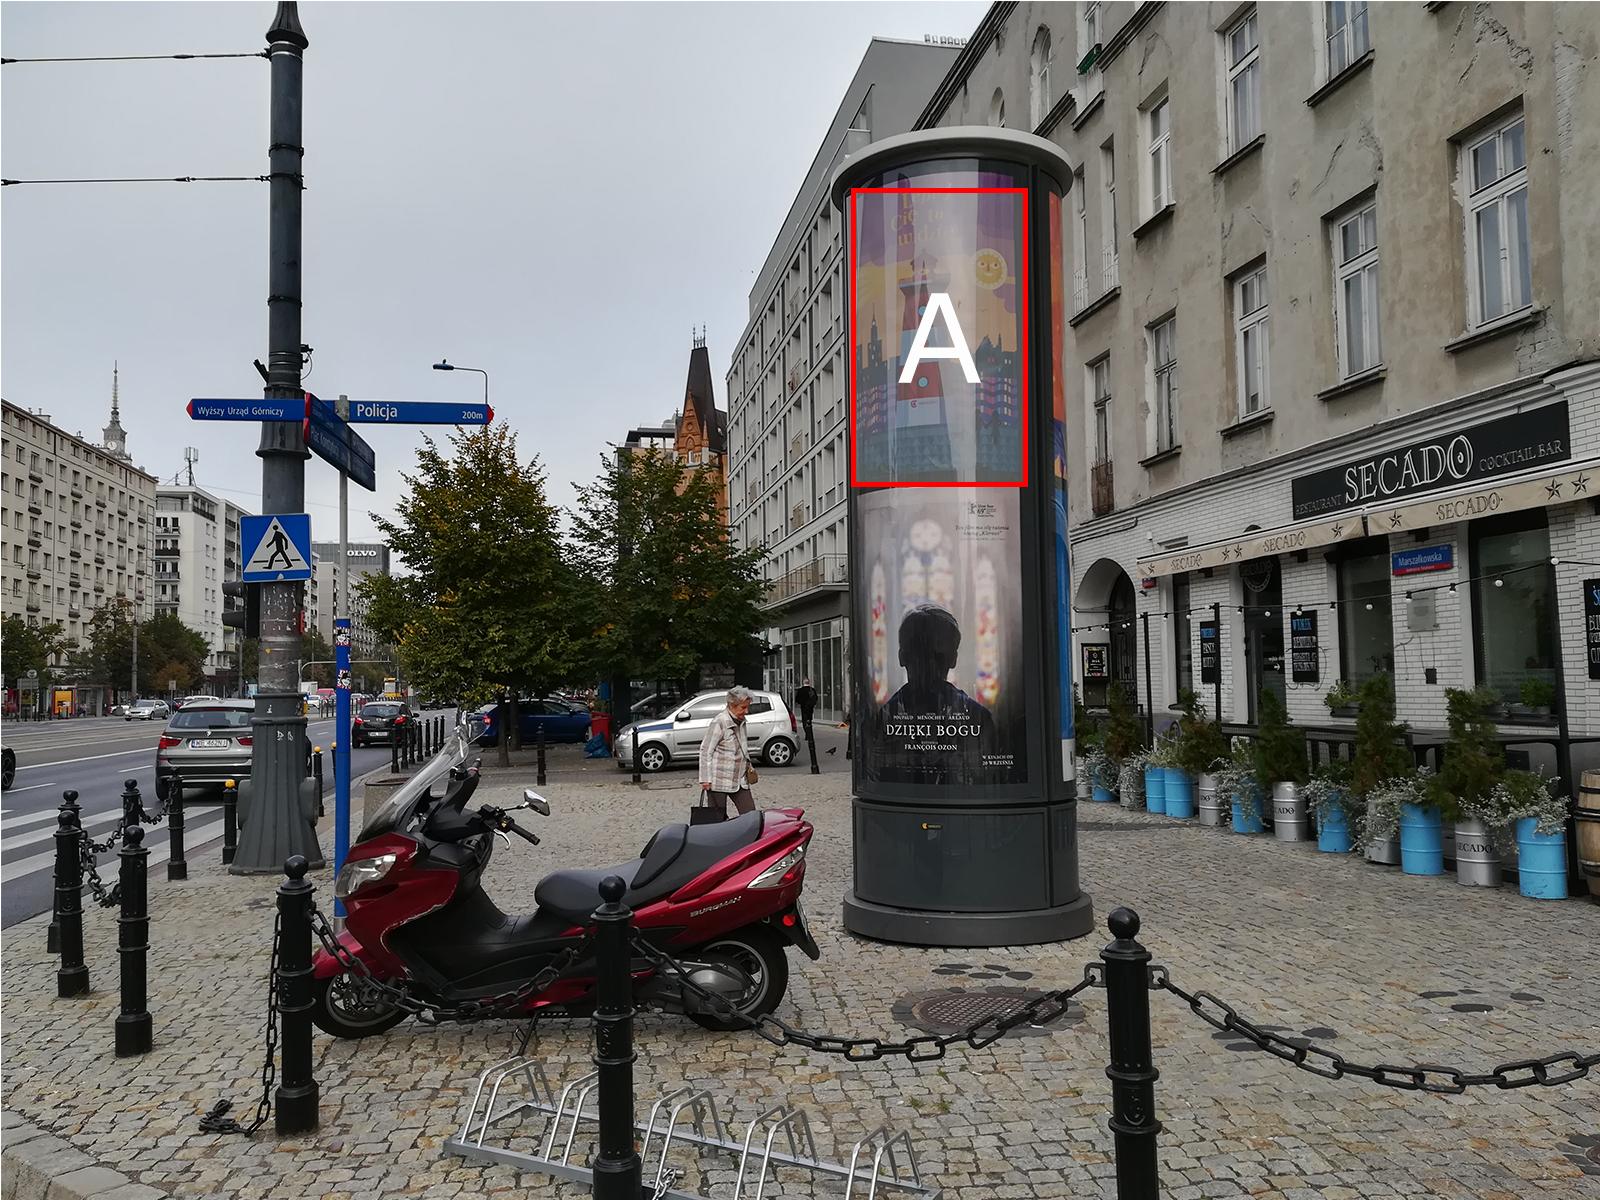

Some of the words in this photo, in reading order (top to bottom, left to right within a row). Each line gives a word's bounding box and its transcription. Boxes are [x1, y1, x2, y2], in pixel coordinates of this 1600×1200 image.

[197, 406, 225, 417] Wyższy
[227, 406, 249, 417] Urząd
[251, 406, 284, 418] Górniczy
[356, 403, 398, 421] Policja
[462, 410, 483, 420] 200m
[1295, 494, 1342, 515] RESTAURANT
[1344, 434, 1474, 503] SECADO
[1478, 446, 1536, 472] COCKTAIL
[1537, 439, 1564, 459] BAR
[1436, 491, 1501, 521] SECADO
[1263, 530, 1306, 553] SECADO
[1171, 553, 1203, 571] SECADO
[1398, 551, 1443, 567] Marszałkowska
[886, 724, 931, 739] DZIĘKI
[936, 725, 981, 736] BOGU
[904, 744, 936, 752] FRANÇOIS
[690, 896, 742, 918] BURGMAN
